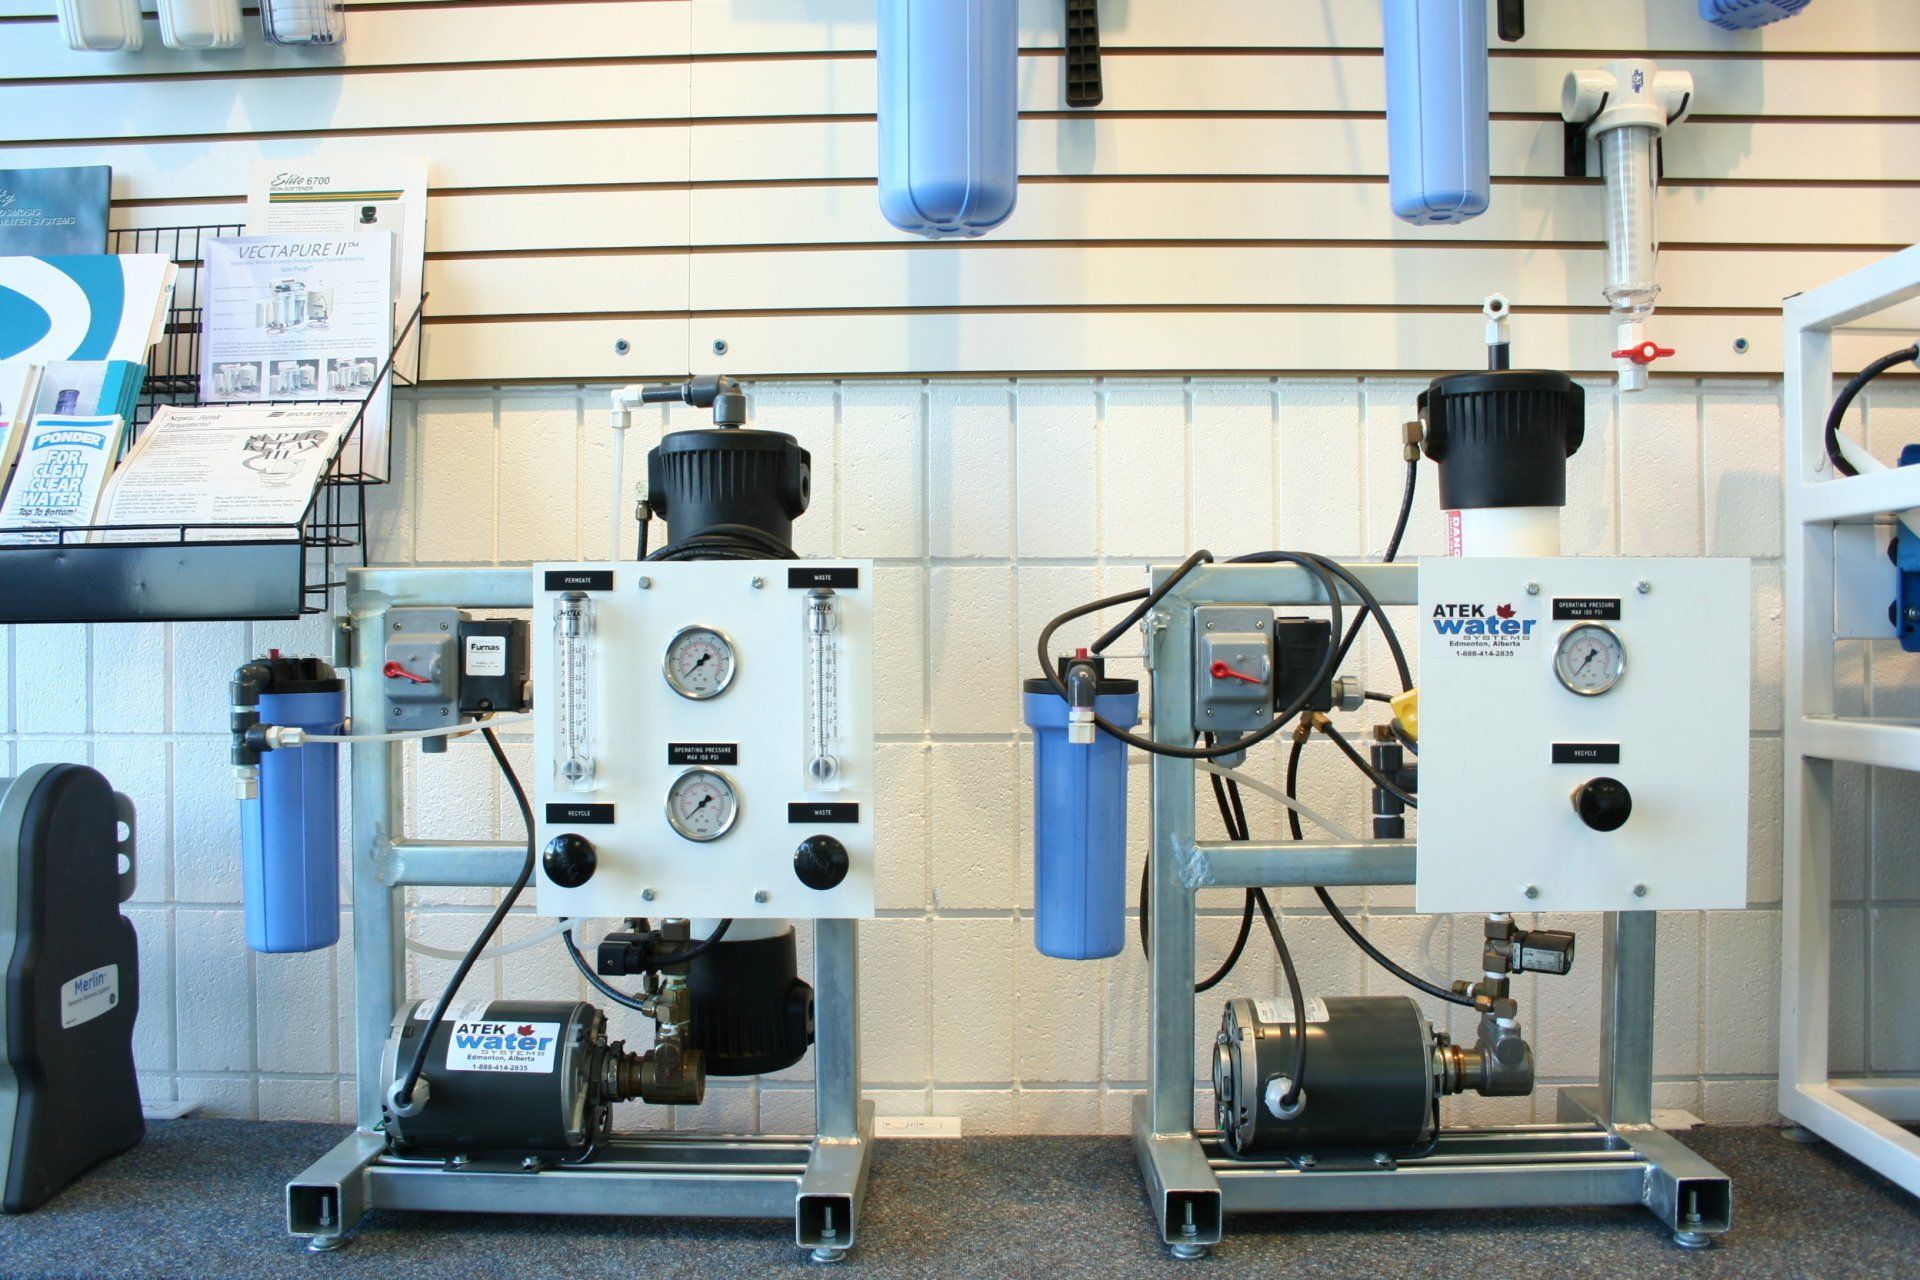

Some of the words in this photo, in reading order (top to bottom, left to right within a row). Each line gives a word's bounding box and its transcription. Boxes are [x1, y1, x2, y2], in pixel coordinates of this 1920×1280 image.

[307, 176, 331, 186] 6700
[33, 217, 76, 226] SYSTEMS
[239, 242, 332, 259] VECTAPURE
[38, 431, 102, 447] PONDER
[46, 450, 81, 465] FOR
[33, 463, 88, 479] CLEAN
[30, 478, 83, 492] CLEAR
[21, 491, 82, 507] WATER
[19, 508, 32, 517] Top
[34, 508, 43, 517] To
[45, 507, 77, 517] Bottom!
[1432, 604, 1485, 617] ATEK
[1432, 614, 1537, 635] water
[471, 643, 501, 651] Furnas
[456, 1023, 507, 1035] ATEK
[455, 1033, 554, 1051] water
